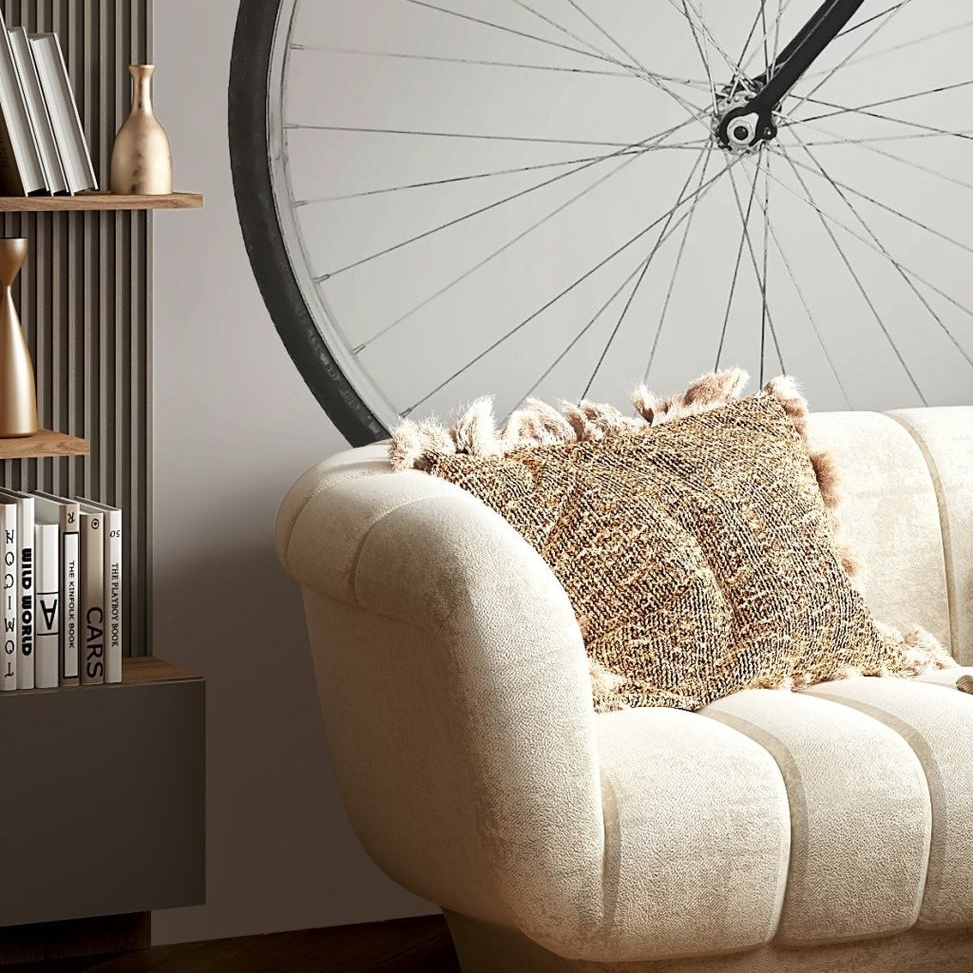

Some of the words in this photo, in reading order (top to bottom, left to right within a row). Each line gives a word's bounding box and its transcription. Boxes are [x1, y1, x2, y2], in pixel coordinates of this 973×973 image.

[21, 548, 32, 590] WILD
[111, 562, 119, 580] THE
[40, 599, 58, 631] A
[111, 582, 119, 621] PLAYBOY
[21, 595, 32, 656] WORLD
[86, 606, 103, 679] CARS
[111, 623, 119, 647] BOOK
